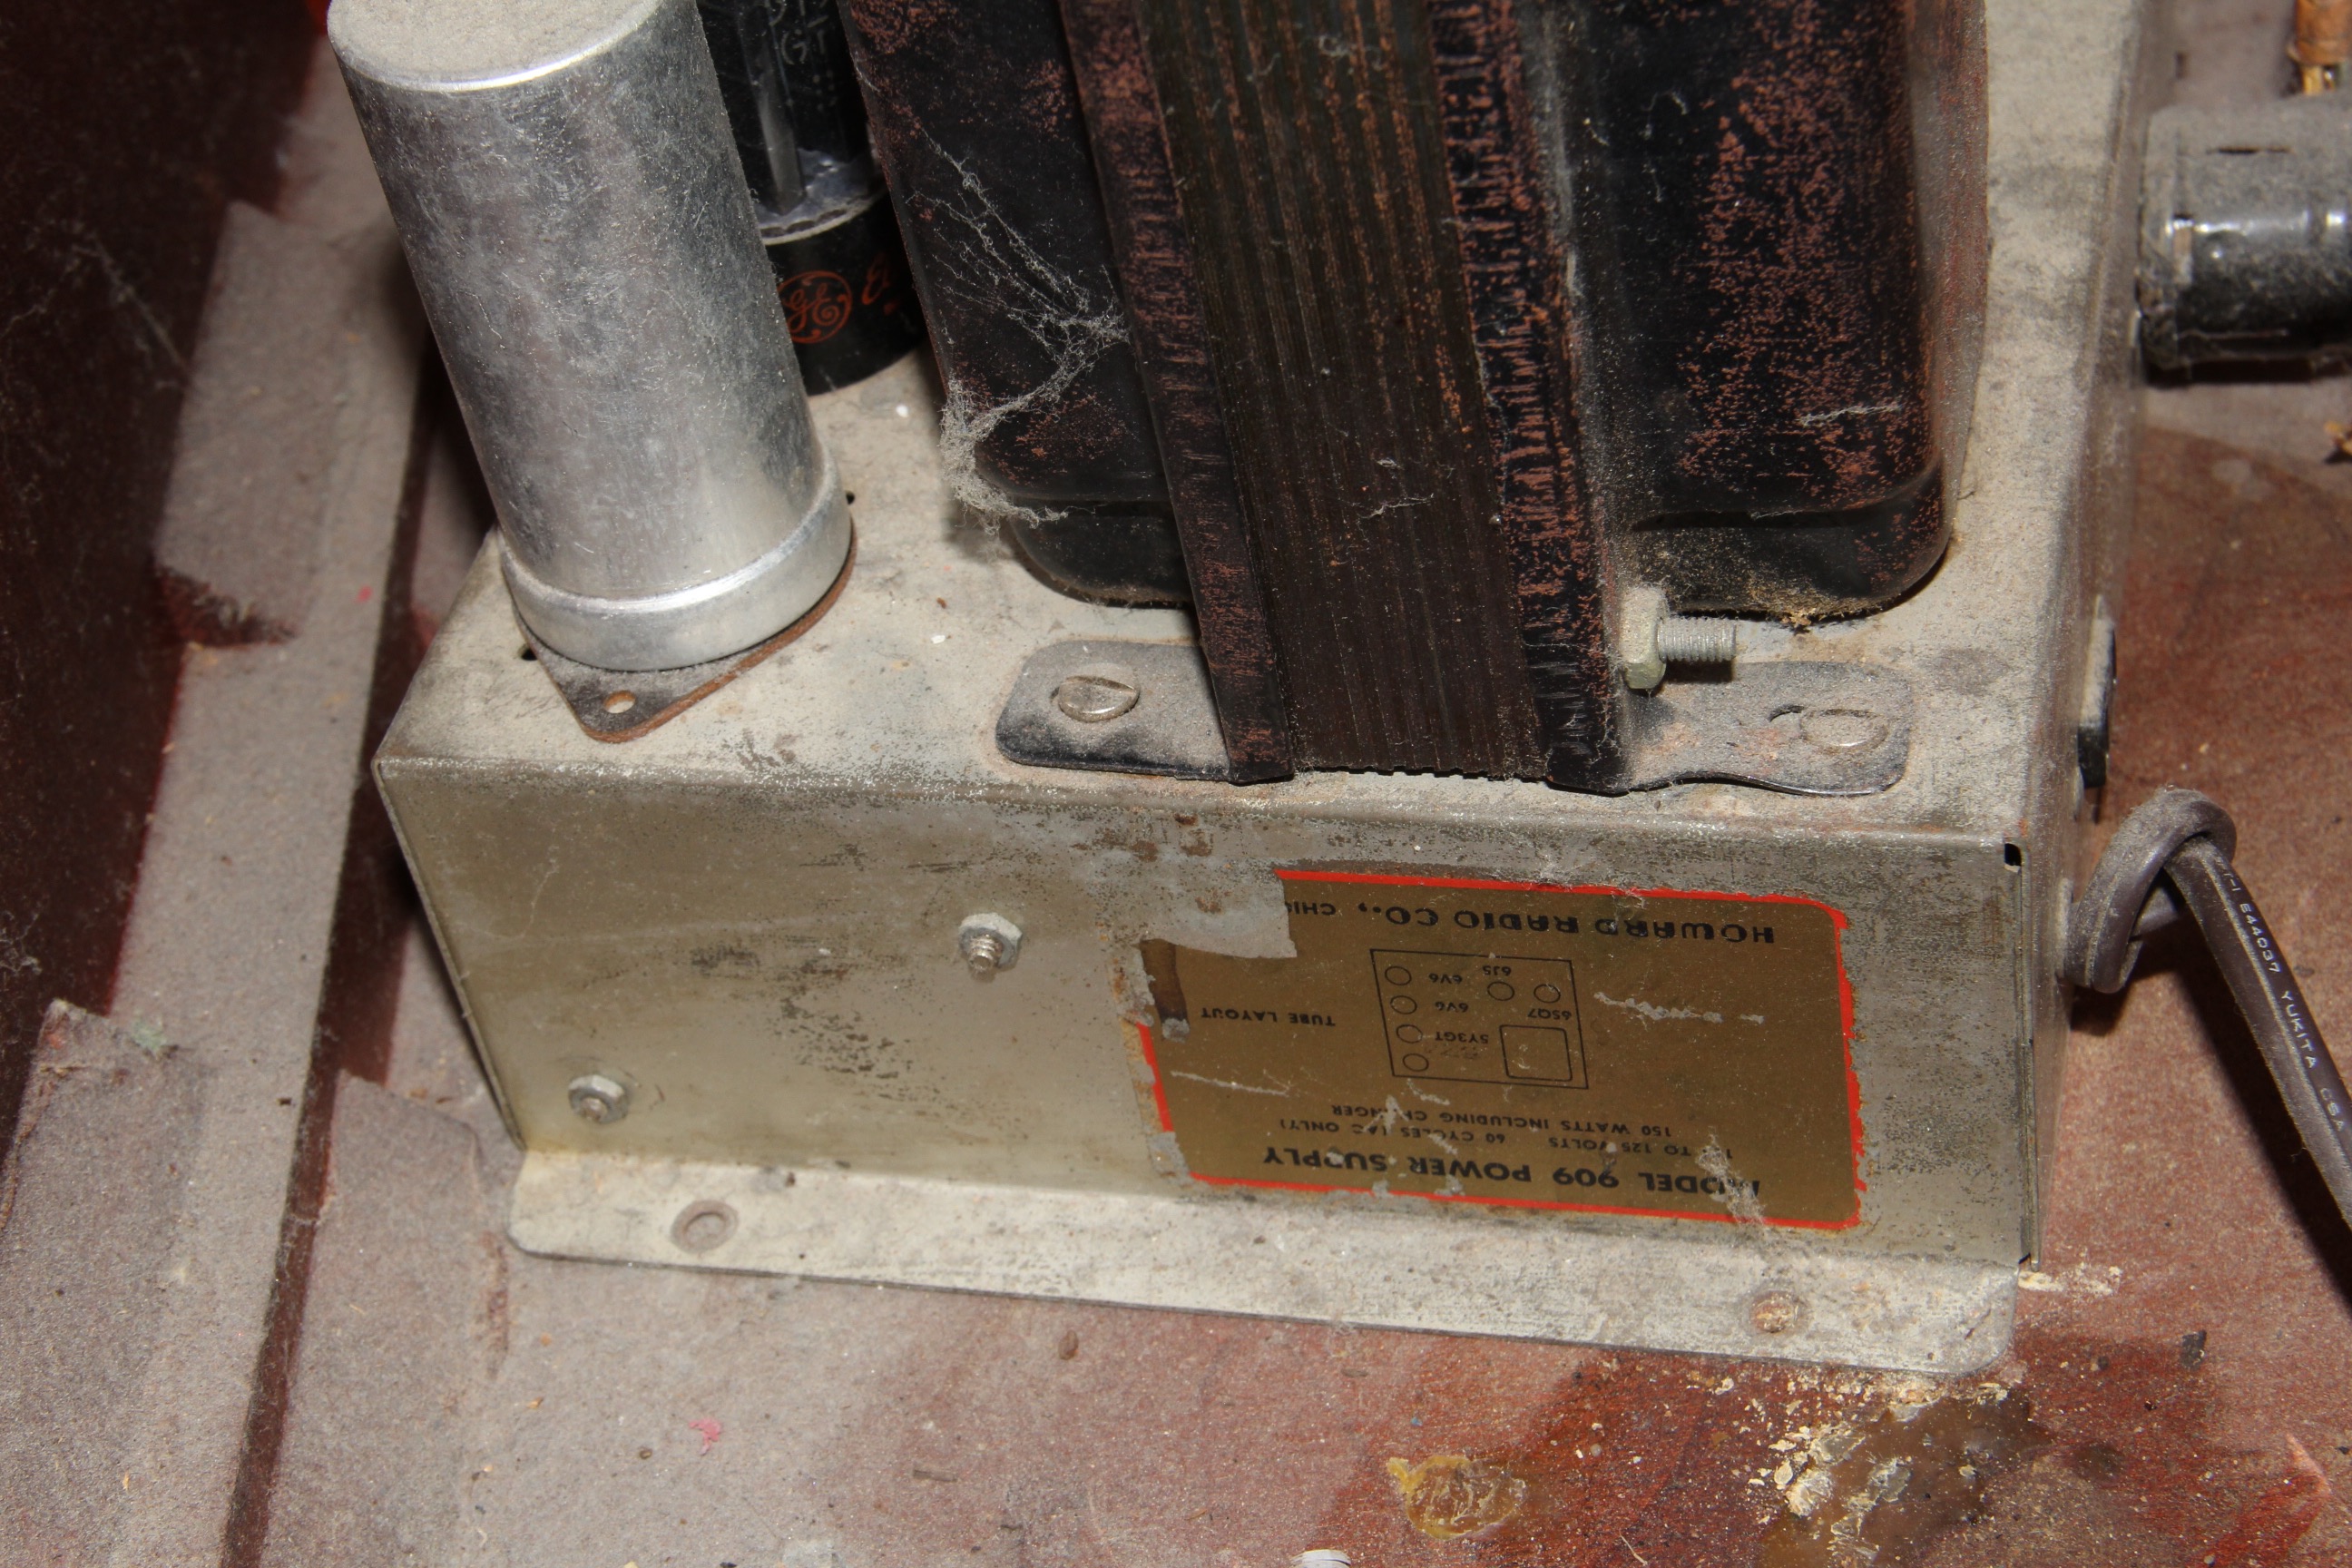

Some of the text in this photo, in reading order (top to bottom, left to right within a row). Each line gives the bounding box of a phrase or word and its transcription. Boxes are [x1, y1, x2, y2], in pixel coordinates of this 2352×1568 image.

[1357, 902, 1439, 926] CO.,
[1454, 910, 1579, 933] RADIO
[1595, 918, 1774, 944] HOWARD
[1428, 973, 1463, 985] 6V6
[1483, 965, 1512, 976] 6J5
[1435, 1001, 1468, 1013] 6V6
[1527, 1008, 1572, 1020] 6SQ7
[1200, 1007, 1336, 1027] TUBE LAYOUT
[2239, 903, 2282, 973] E44037
[2281, 990, 2317, 1069] YUKITA
[2320, 1088, 2346, 1132] CSA
[1434, 1031, 1489, 1044] 5Y3GT
[1279, 1118, 1339, 1132] ONLY)
[1331, 1103, 1671, 1137] 150 WATTS INCLUDING CHNGER
[1485, 1132, 1505, 1143] 60
[1621, 1142, 1651, 1154] 125
[1664, 1145, 1691, 1156] TO
[1263, 1147, 1387, 1172] SUPPLY
[1407, 1156, 1532, 1181] POWER
[1553, 1167, 1619, 1188] 909
